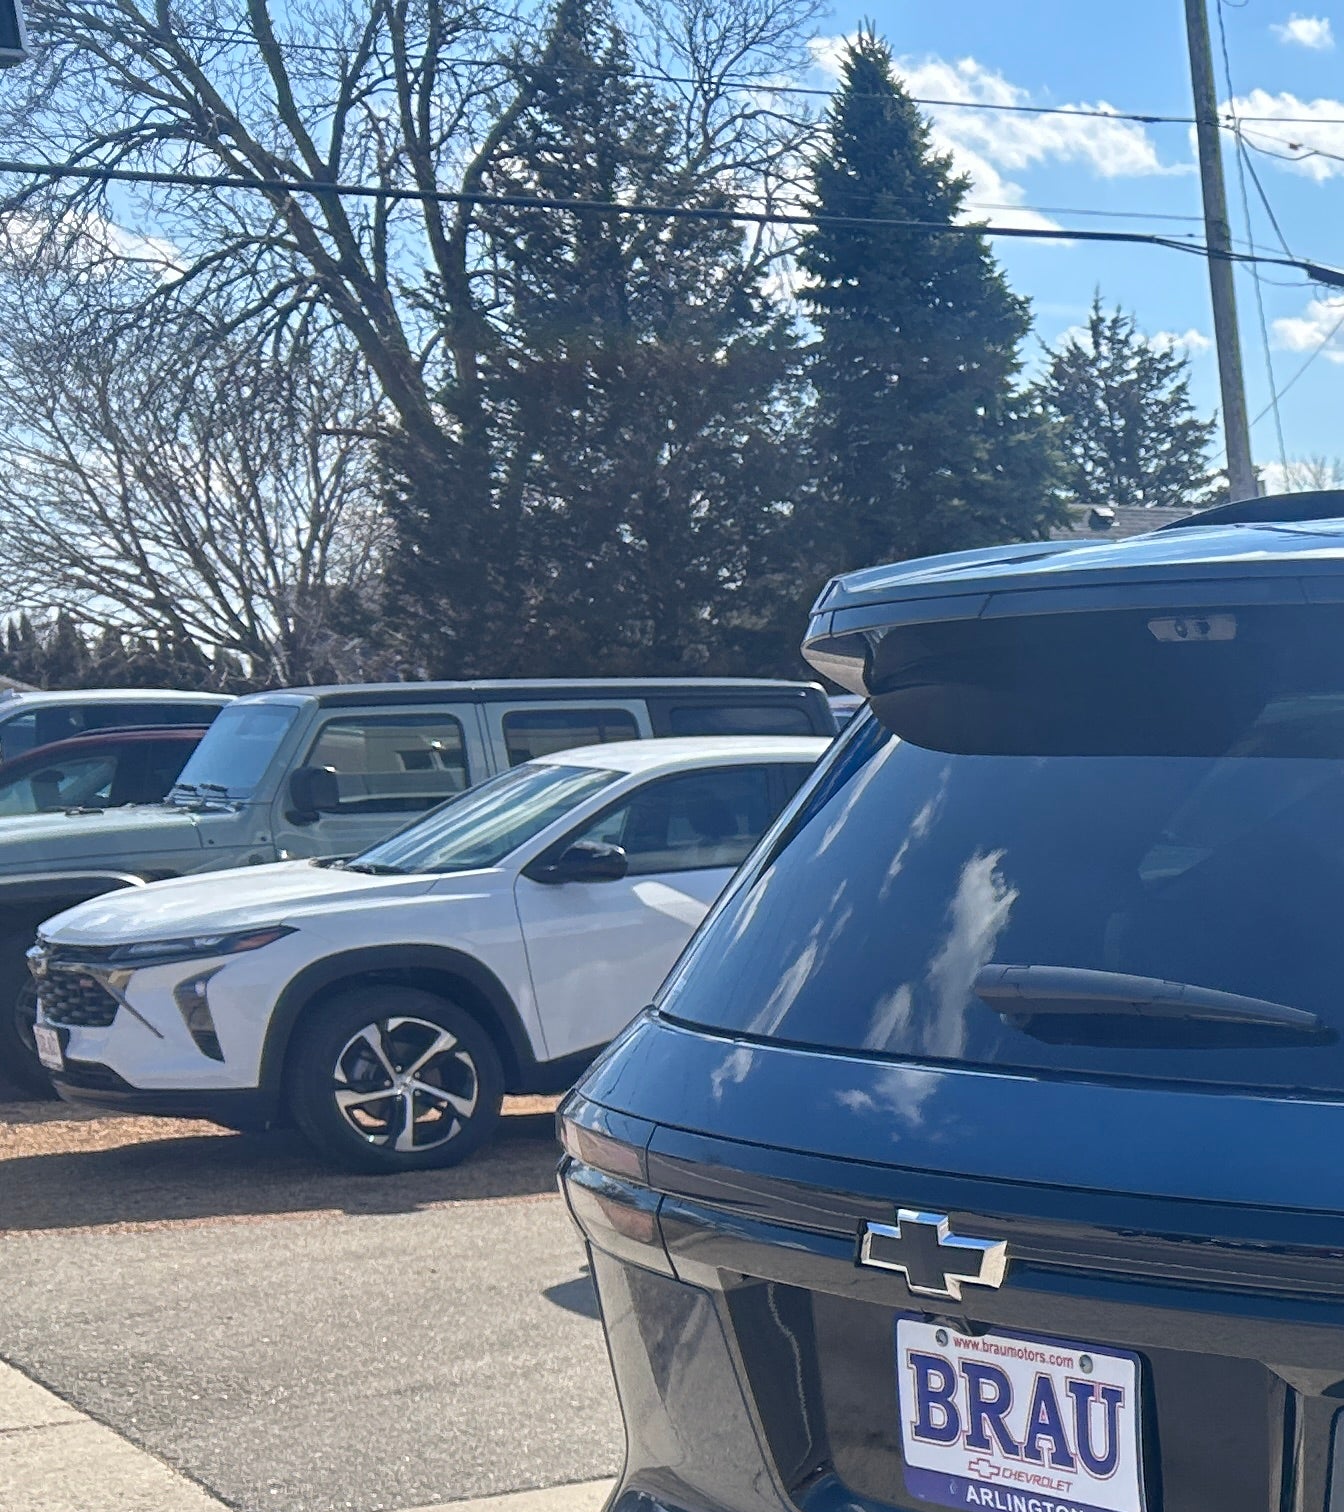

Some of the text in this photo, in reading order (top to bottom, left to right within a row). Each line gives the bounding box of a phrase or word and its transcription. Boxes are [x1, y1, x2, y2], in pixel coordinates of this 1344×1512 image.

[953, 1336, 1074, 1369] www.braumotors.com
[906, 1348, 1126, 1481] BRAU
[999, 1467, 1074, 1493] CHEVROLET
